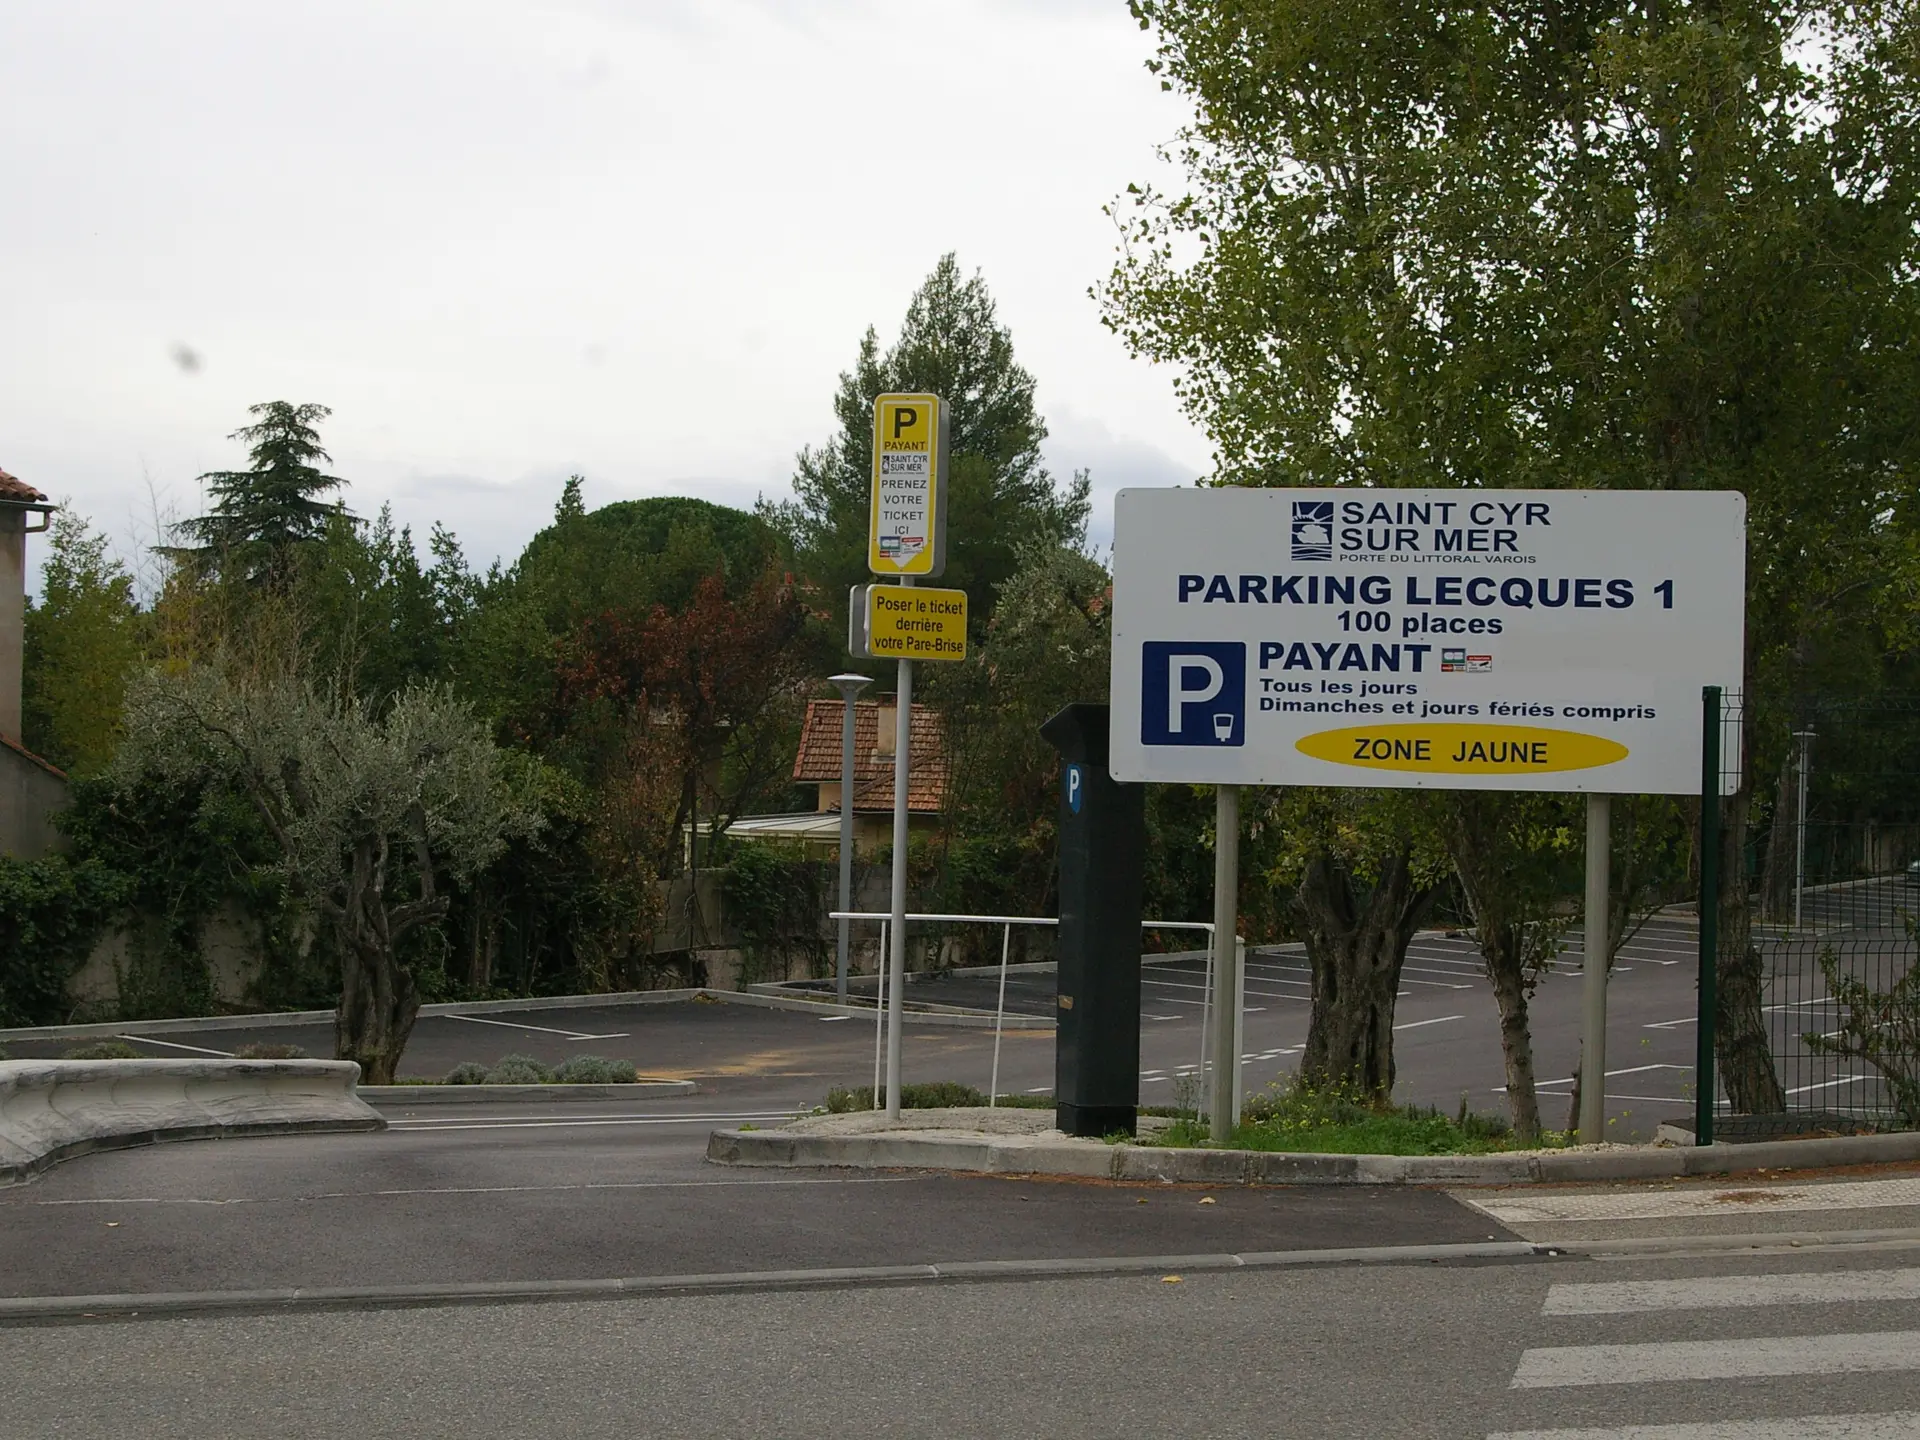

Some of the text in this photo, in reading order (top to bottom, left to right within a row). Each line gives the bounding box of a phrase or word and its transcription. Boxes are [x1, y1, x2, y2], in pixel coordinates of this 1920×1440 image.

[894, 407, 917, 438] P
[884, 441, 925, 450] PAYANT
[890, 455, 928, 463] SAINT CYR
[881, 480, 927, 489] PRENEZ
[884, 495, 922, 504] VOTRE
[883, 511, 924, 520] TICKET
[1341, 502, 1551, 526] SAINT CYR
[894, 526, 909, 535] ICI
[1340, 528, 1519, 552] SUR MER
[1340, 554, 1537, 564] PORTE DU LITTORAL VAROIS
[1178, 575, 1673, 609] PARKING LECQUES 1
[877, 596, 963, 615] Poser le ticket
[896, 617, 943, 632] derrière
[1337, 610, 1503, 638] 100 places
[875, 636, 963, 652] votre Pare-Brise
[1259, 642, 1432, 673] PAYANT
[1168, 655, 1224, 733] P
[1260, 678, 1418, 697] Tous les jours
[1259, 697, 1656, 722] Dimanches et jours fériés compris
[1353, 738, 1548, 763] ZONE JAUNE
[1069, 768, 1080, 803] P
